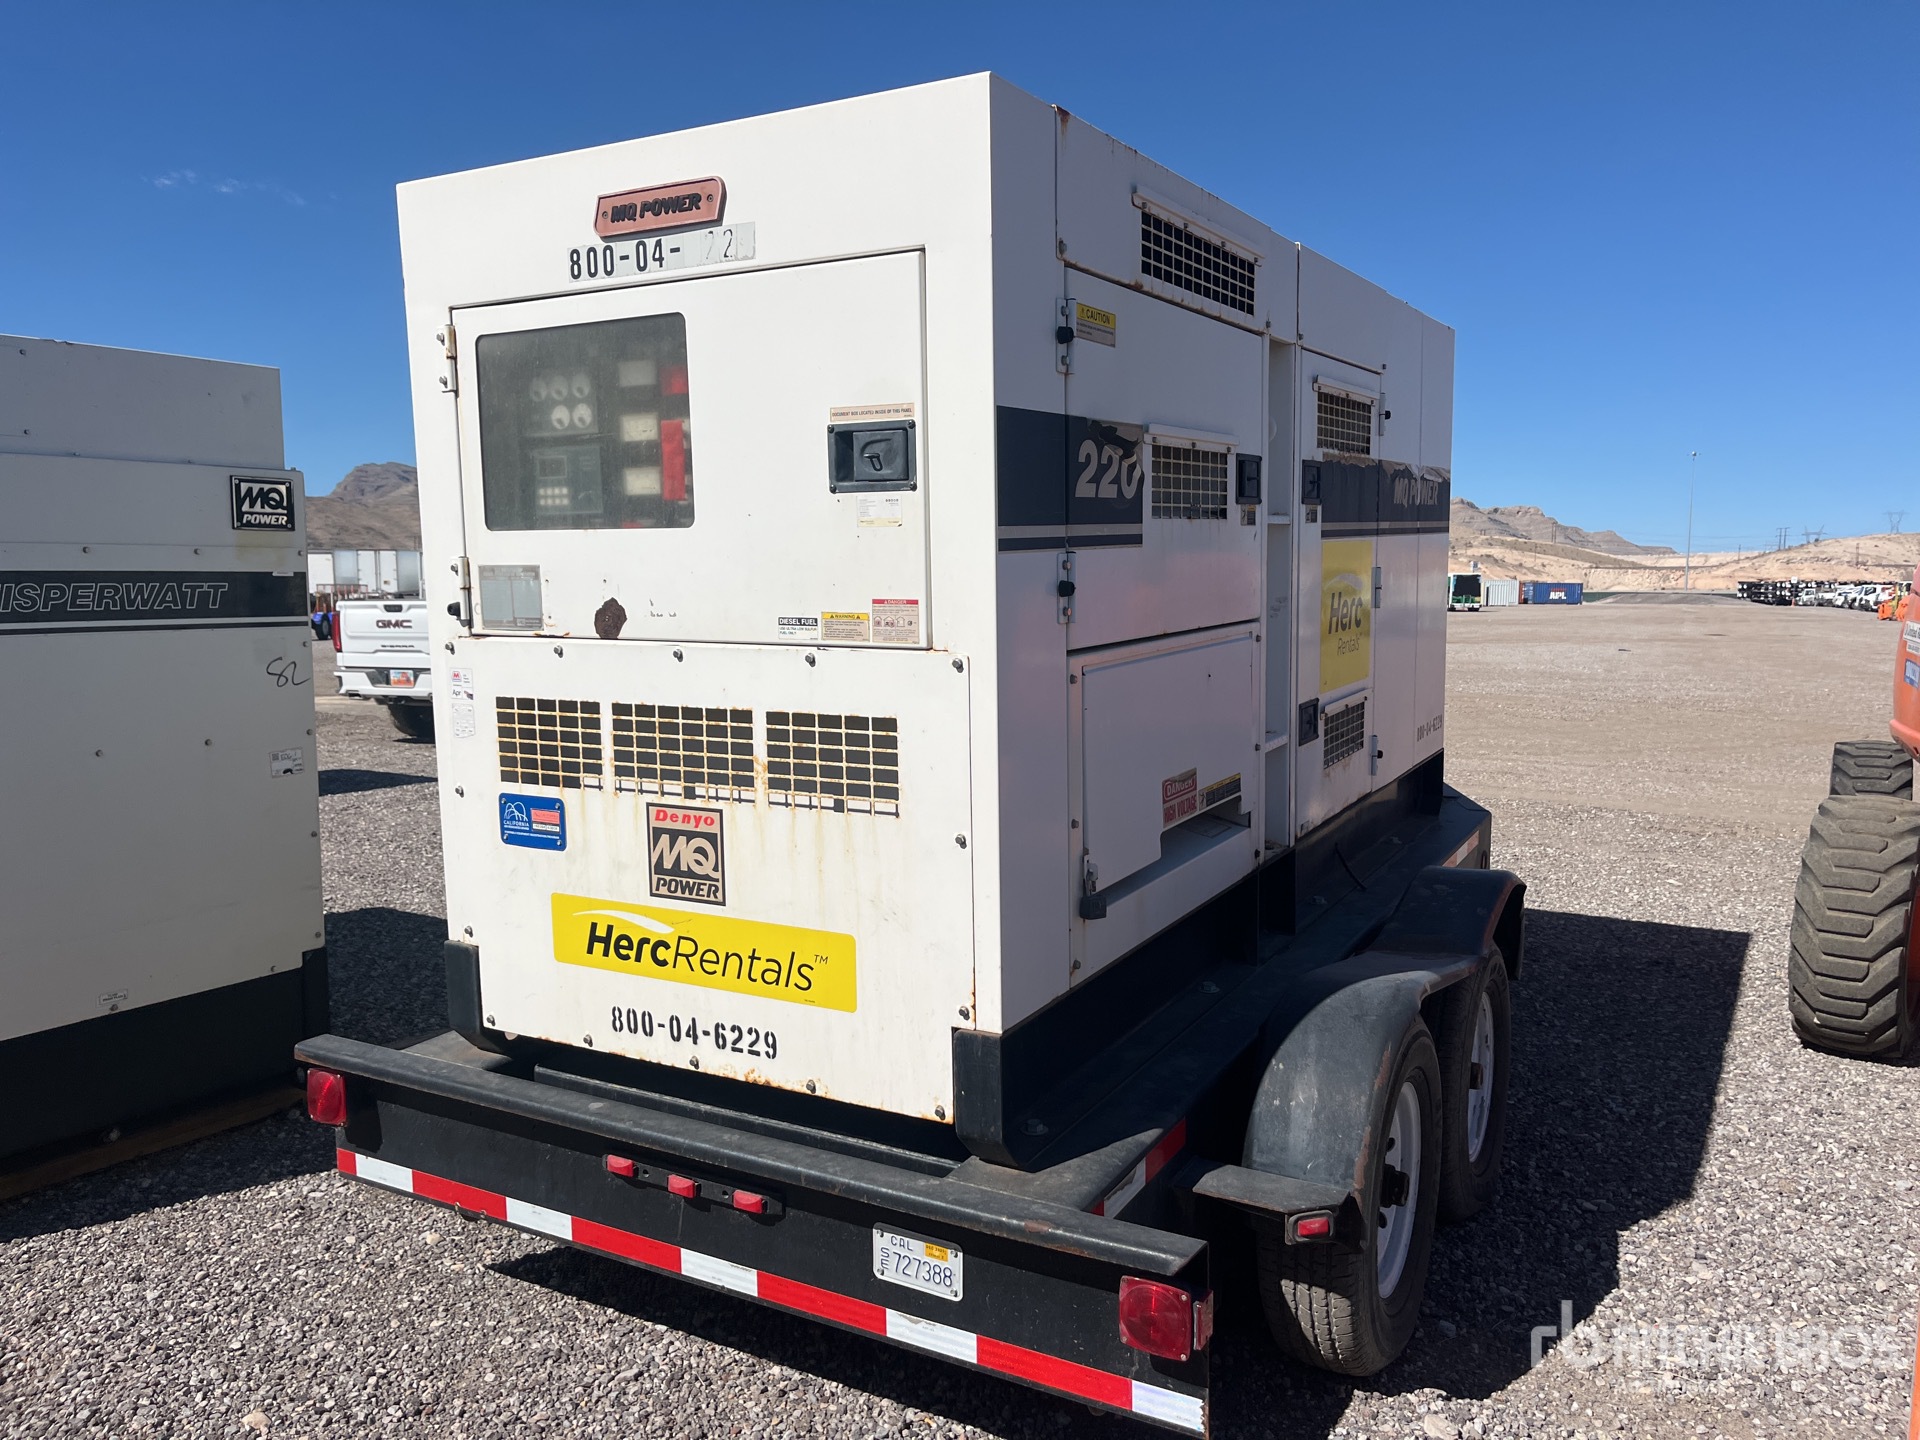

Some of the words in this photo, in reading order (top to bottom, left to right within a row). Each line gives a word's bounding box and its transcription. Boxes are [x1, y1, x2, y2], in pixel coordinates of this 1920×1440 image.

[611, 203, 637, 223] MQ
[639, 193, 702, 219] POWER
[1086, 308, 1111, 325] CAUTION
[1075, 439, 1142, 499] 220
[238, 486, 287, 511] MQ
[242, 513, 288, 526] POWER
[0, 583, 229, 613] ISPERWATT
[1549, 591, 1567, 600] APL
[376, 620, 412, 628] GMC
[1328, 592, 1363, 635] Herc
[1337, 635, 1360, 656] Rentals
[1167, 780, 1193, 797] DANGER
[655, 809, 715, 828] Denyo
[653, 834, 719, 879] MQ
[655, 877, 719, 899] POWER
[611, 1006, 778, 1060] 800-04-6229
[890, 1235, 913, 1252] CAL
[893, 1252, 952, 1288] 727388
